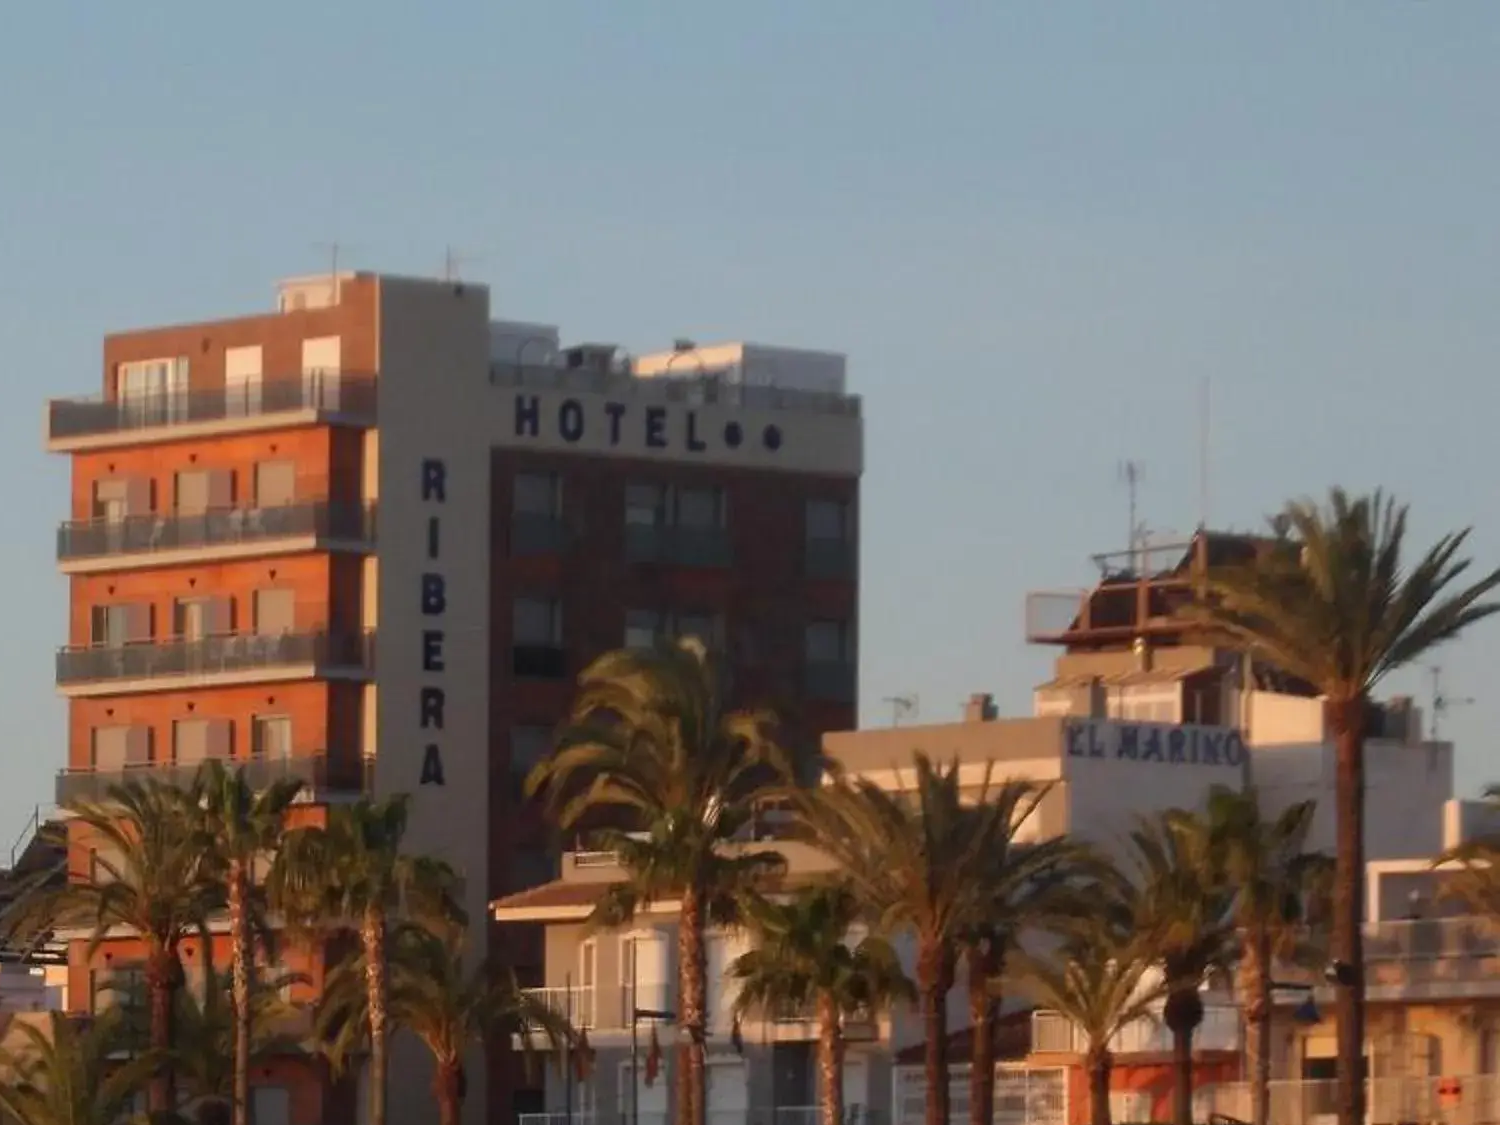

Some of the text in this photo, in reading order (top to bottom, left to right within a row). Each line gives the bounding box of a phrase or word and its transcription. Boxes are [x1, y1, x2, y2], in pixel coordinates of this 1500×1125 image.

[514, 395, 707, 452] HOTEL
[420, 458, 446, 787] RIBERA
[1067, 724, 1105, 758] EL
